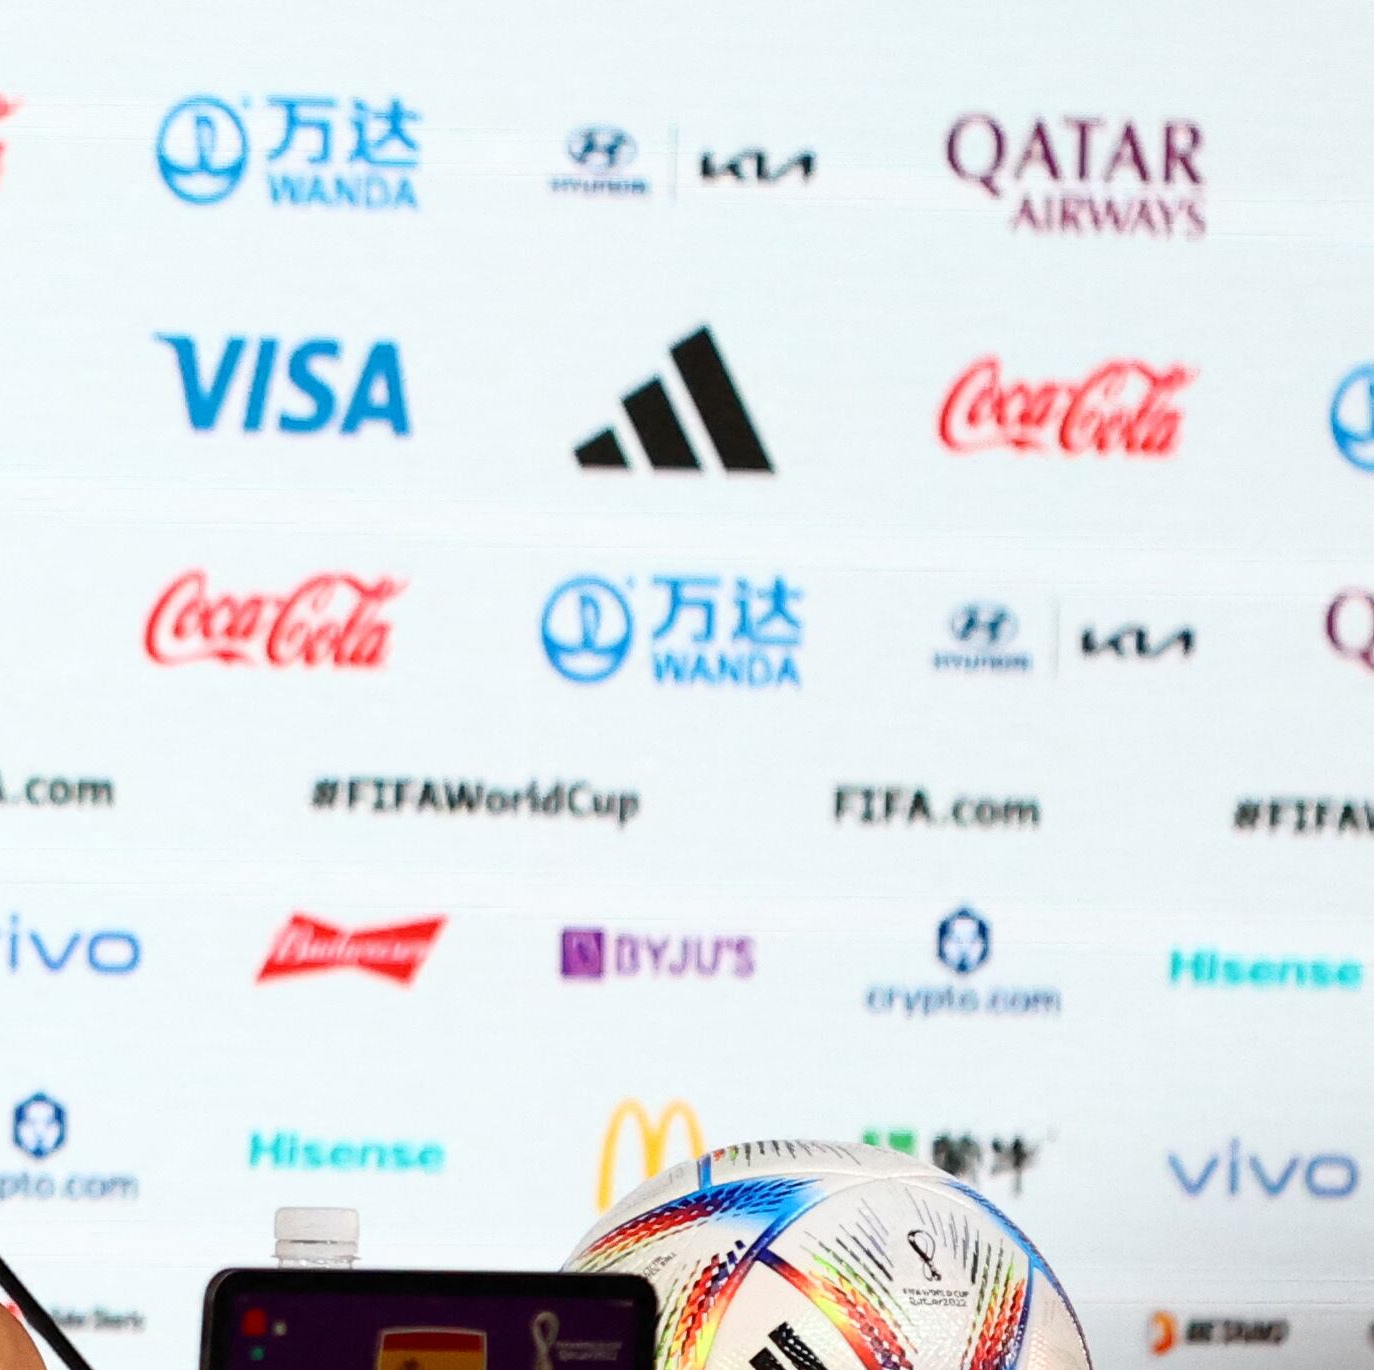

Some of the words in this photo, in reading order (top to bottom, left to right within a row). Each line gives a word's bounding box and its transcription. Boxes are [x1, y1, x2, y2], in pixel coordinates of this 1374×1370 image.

[268, 97, 418, 168] 万达
[946, 117, 1202, 197] QATAR
[267, 173, 417, 208] WANDA
[1014, 195, 1205, 234] AIRWAYS
[158, 335, 410, 436] VISA
[937, 358, 1192, 457] Coca-Cola
[143, 571, 398, 668] Coca-Cola
[653, 577, 800, 647] 万达
[652, 651, 801, 688] WANDA
[312, 777, 639, 827] #FIFAWorldCup
[834, 786, 1040, 826] FIFA.com
[1169, 950, 1363, 988] Hisense
[249, 1132, 445, 1171] Hisense
[1168, 1139, 1361, 1201] vivo
